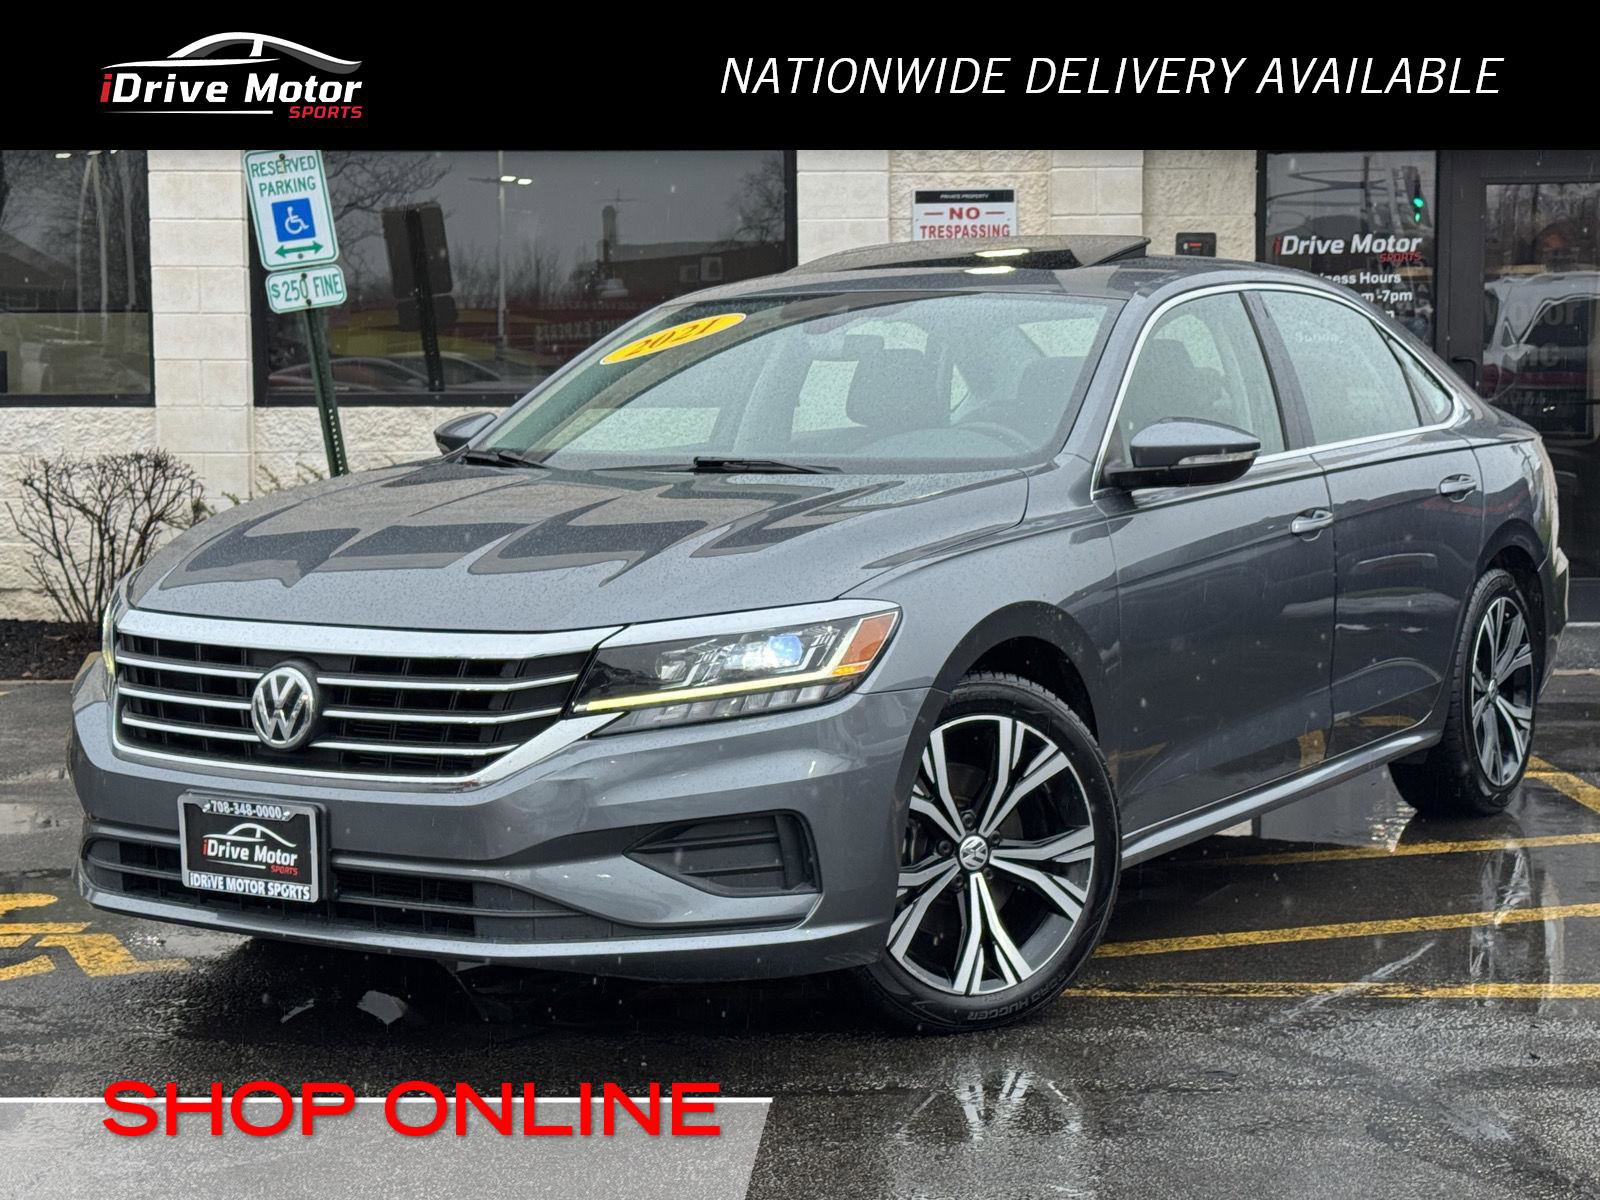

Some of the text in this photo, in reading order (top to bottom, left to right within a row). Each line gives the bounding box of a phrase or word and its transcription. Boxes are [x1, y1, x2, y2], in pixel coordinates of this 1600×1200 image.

[251, 155, 317, 178] RESERVED
[258, 176, 316, 198] PARKING
[948, 207, 980, 220] NO
[920, 224, 1010, 239] TRESPASSING
[1273, 233, 1423, 256] iDrive Motor
[1379, 252, 1422, 263] SPORTS
[271, 273, 343, 302] $250 FINE
[1360, 271, 1402, 284] Hours
[624, 318, 720, 357] 2021
[210, 800, 282, 819] 708-348-0000
[202, 838, 298, 866] iDrive Motor
[270, 864, 299, 876] SPORTS
[225, 878, 266, 896] MOTOR
[267, 882, 310, 900] SPORTS
